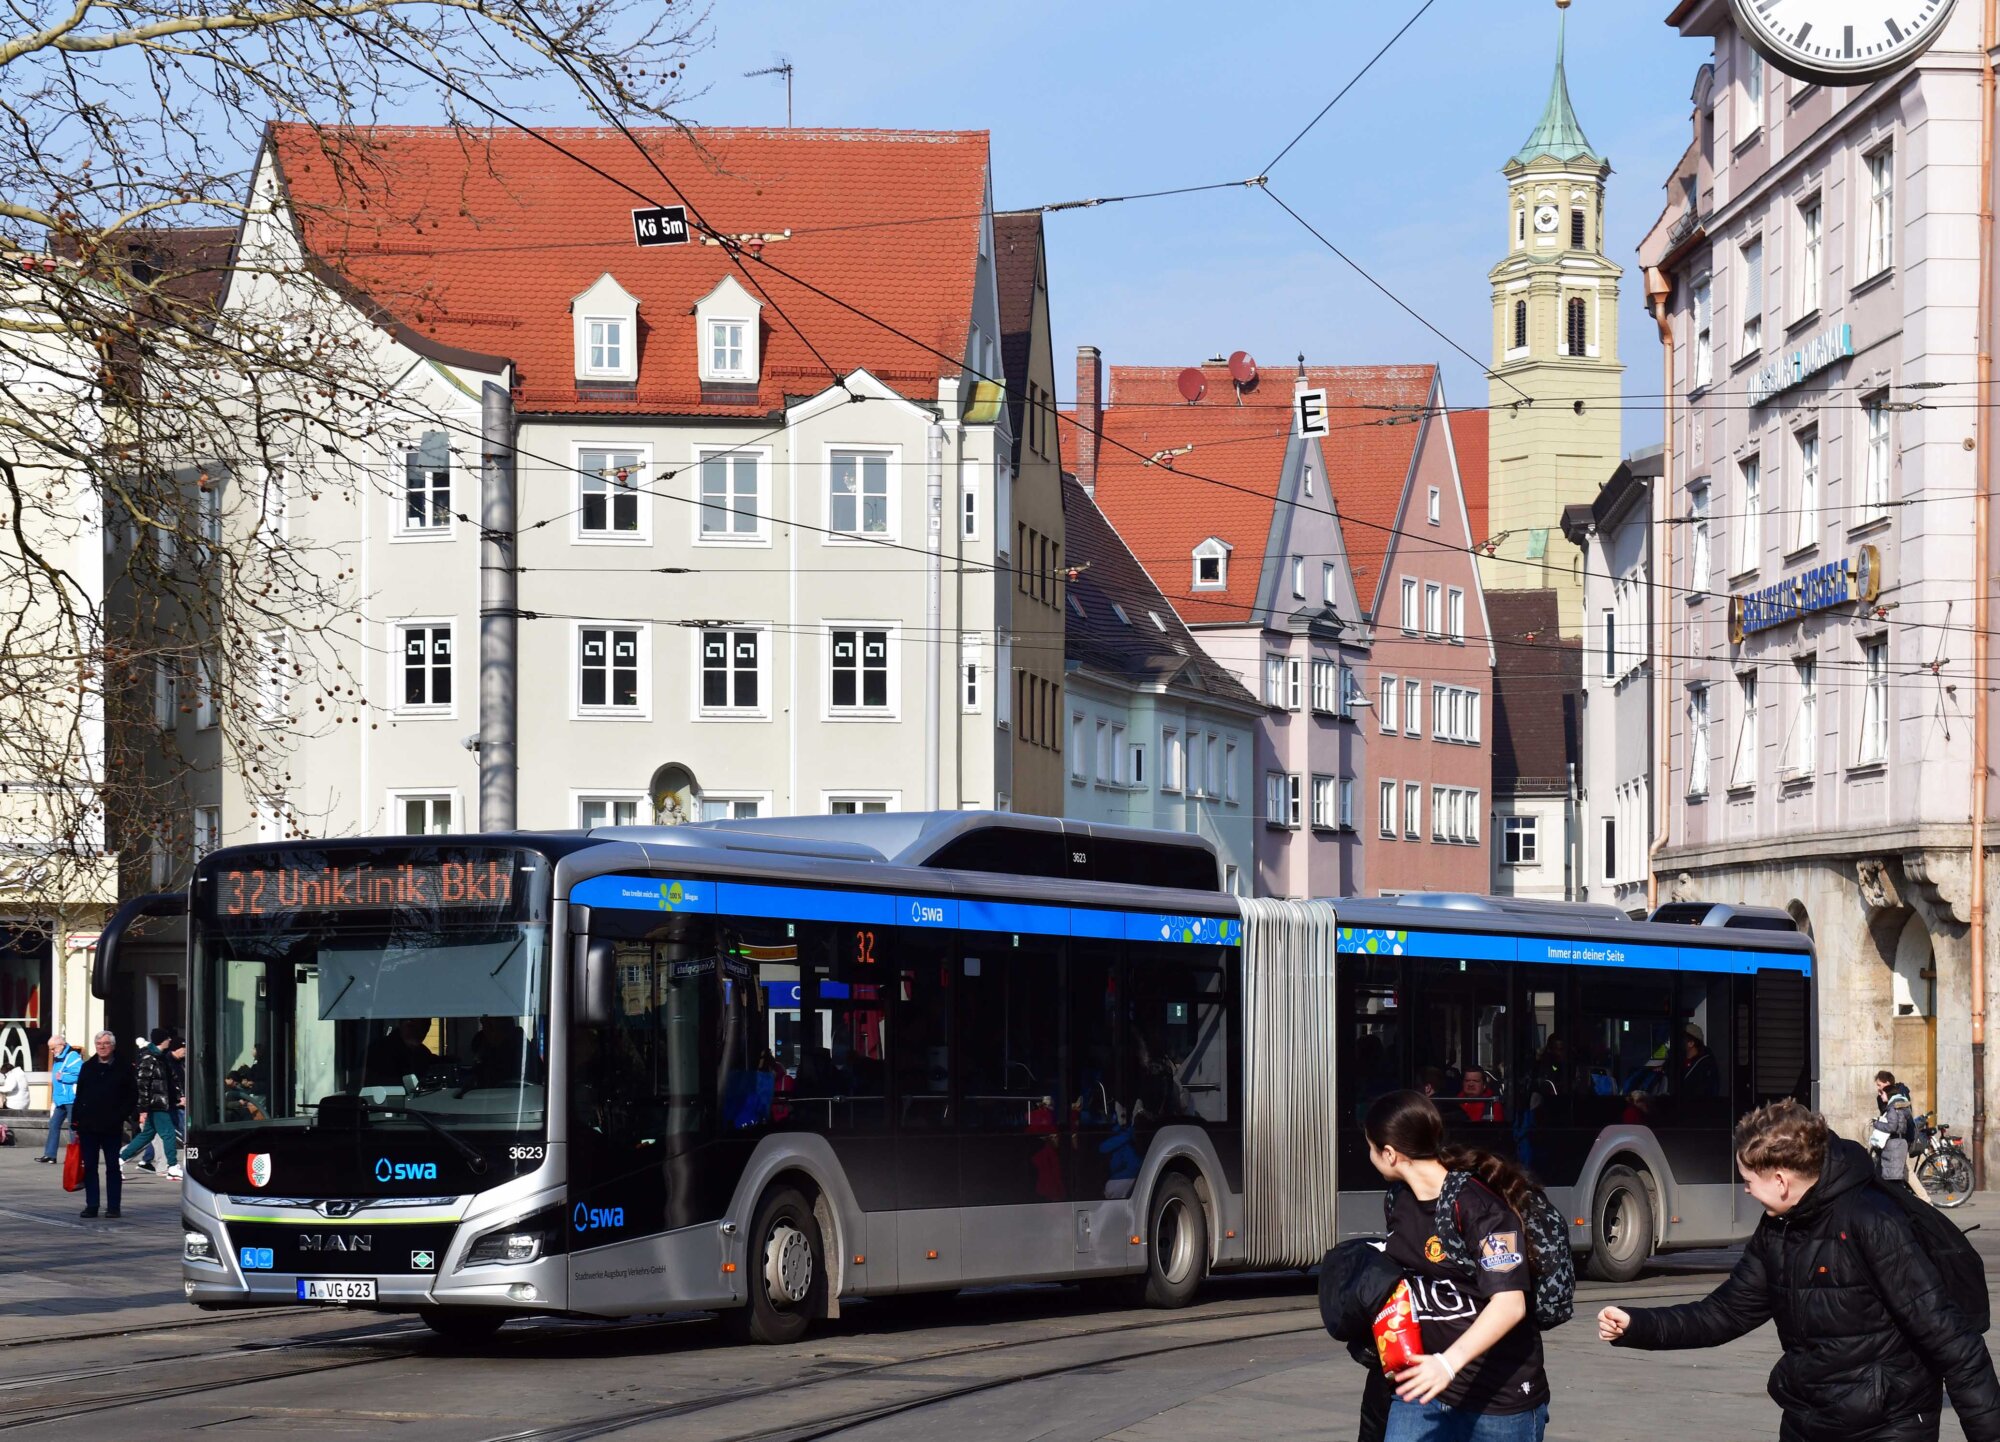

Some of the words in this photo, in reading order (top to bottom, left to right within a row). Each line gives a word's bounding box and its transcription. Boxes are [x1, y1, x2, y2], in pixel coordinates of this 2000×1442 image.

[638, 218, 657, 237] Kö
[661, 216, 684, 235] 5m
[1300, 394, 1324, 433] E
[1072, 852, 1087, 864] 3623
[227, 870, 266, 915] 32
[278, 864, 427, 906] Uniklinik
[441, 861, 511, 902] Bkh
[921, 907, 943, 922] swa
[857, 931, 875, 963] 32
[1547, 946, 1571, 959] Immer
[1572, 950, 1581, 960] an
[1582, 948, 1605, 961] deiner
[1606, 949, 1625, 962] Seite
[508, 1146, 544, 1160] 3623
[395, 1162, 437, 1180] swa
[590, 1206, 624, 1229] swa
[300, 1234, 372, 1251] MAN
[604, 1269, 627, 1280] Augsburg
[309, 1282, 317, 1297] A
[326, 1283, 343, 1297] VG
[347, 1283, 371, 1298] 623
